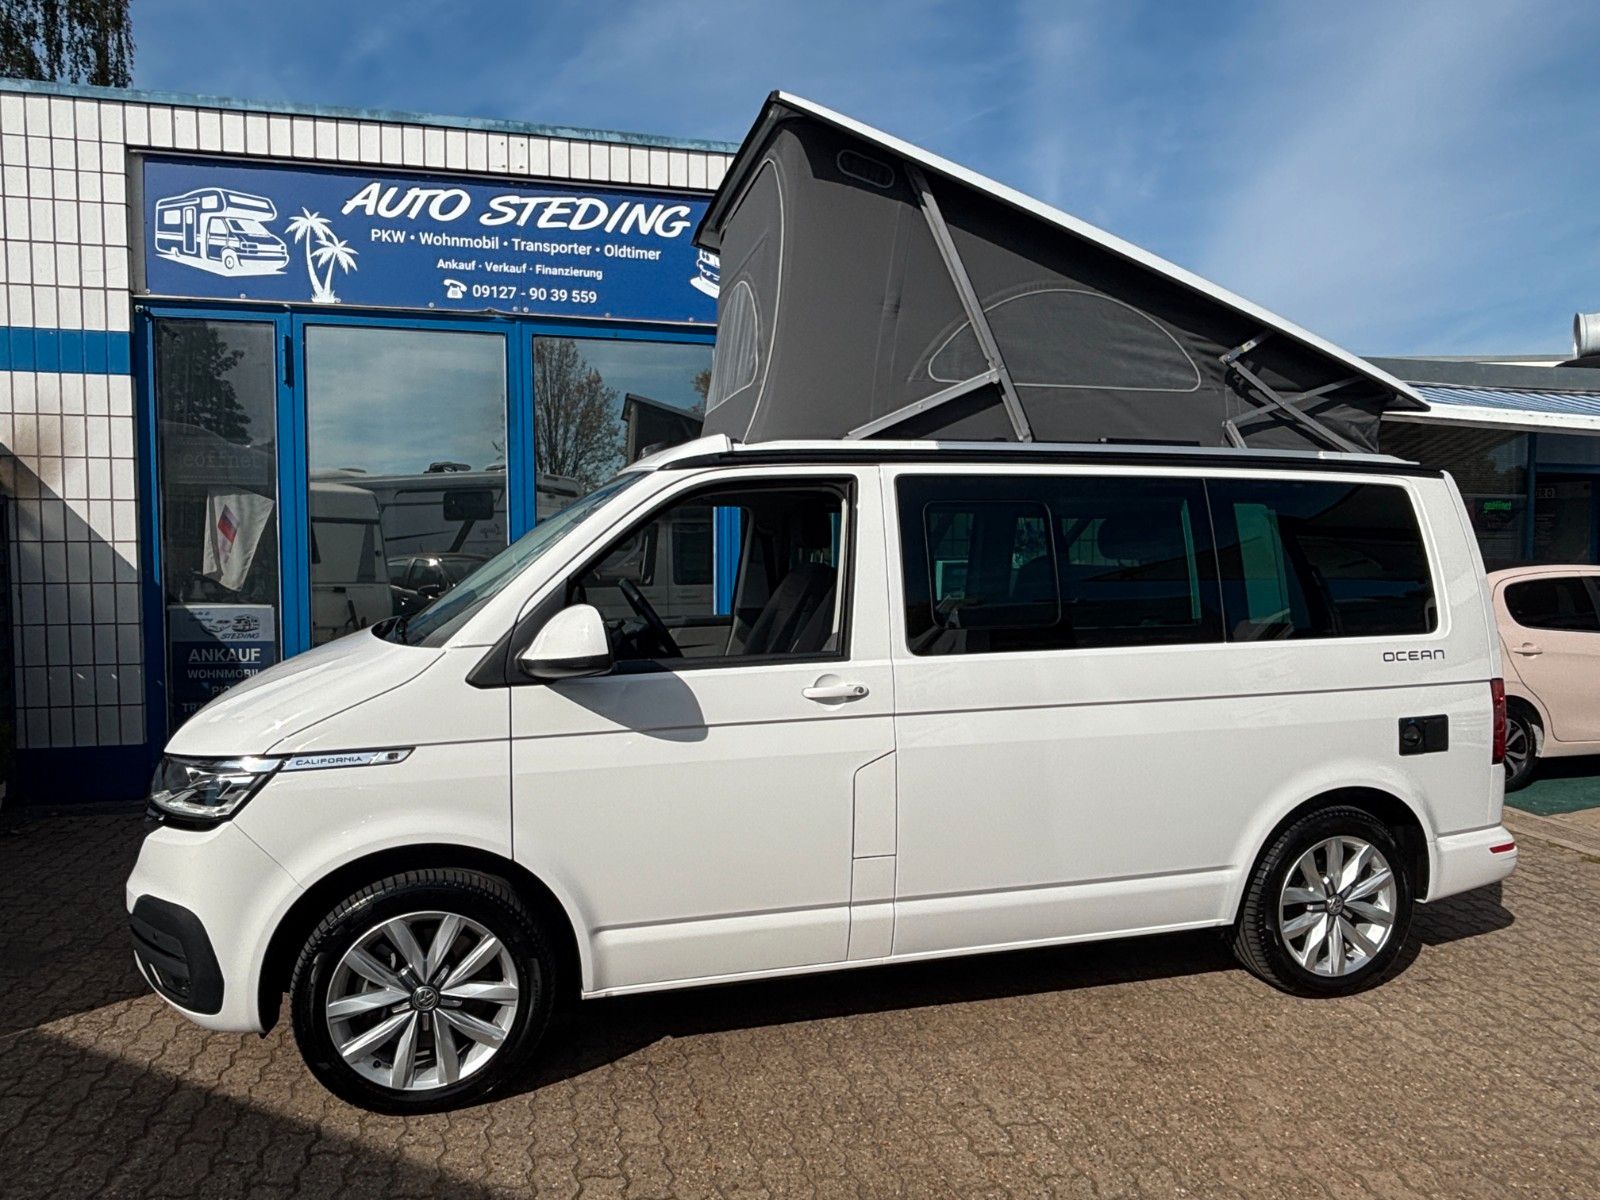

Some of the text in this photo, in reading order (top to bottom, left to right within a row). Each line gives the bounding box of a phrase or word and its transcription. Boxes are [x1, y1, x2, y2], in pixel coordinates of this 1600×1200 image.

[341, 182, 691, 238] AUTO STEDING
[371, 229, 661, 260] PKW Wohnmobil Transporter Oldtimer
[436, 258, 603, 281] Ankauf Verkauf Finanzierung
[472, 285, 517, 299] 09127
[529, 287, 547, 301] 90
[550, 288, 568, 302] 39
[571, 289, 598, 304] 559
[188, 648, 261, 662] ANKAUF
[1383, 649, 1445, 662] OCEAN
[295, 756, 363, 766] CALIFORNIA
